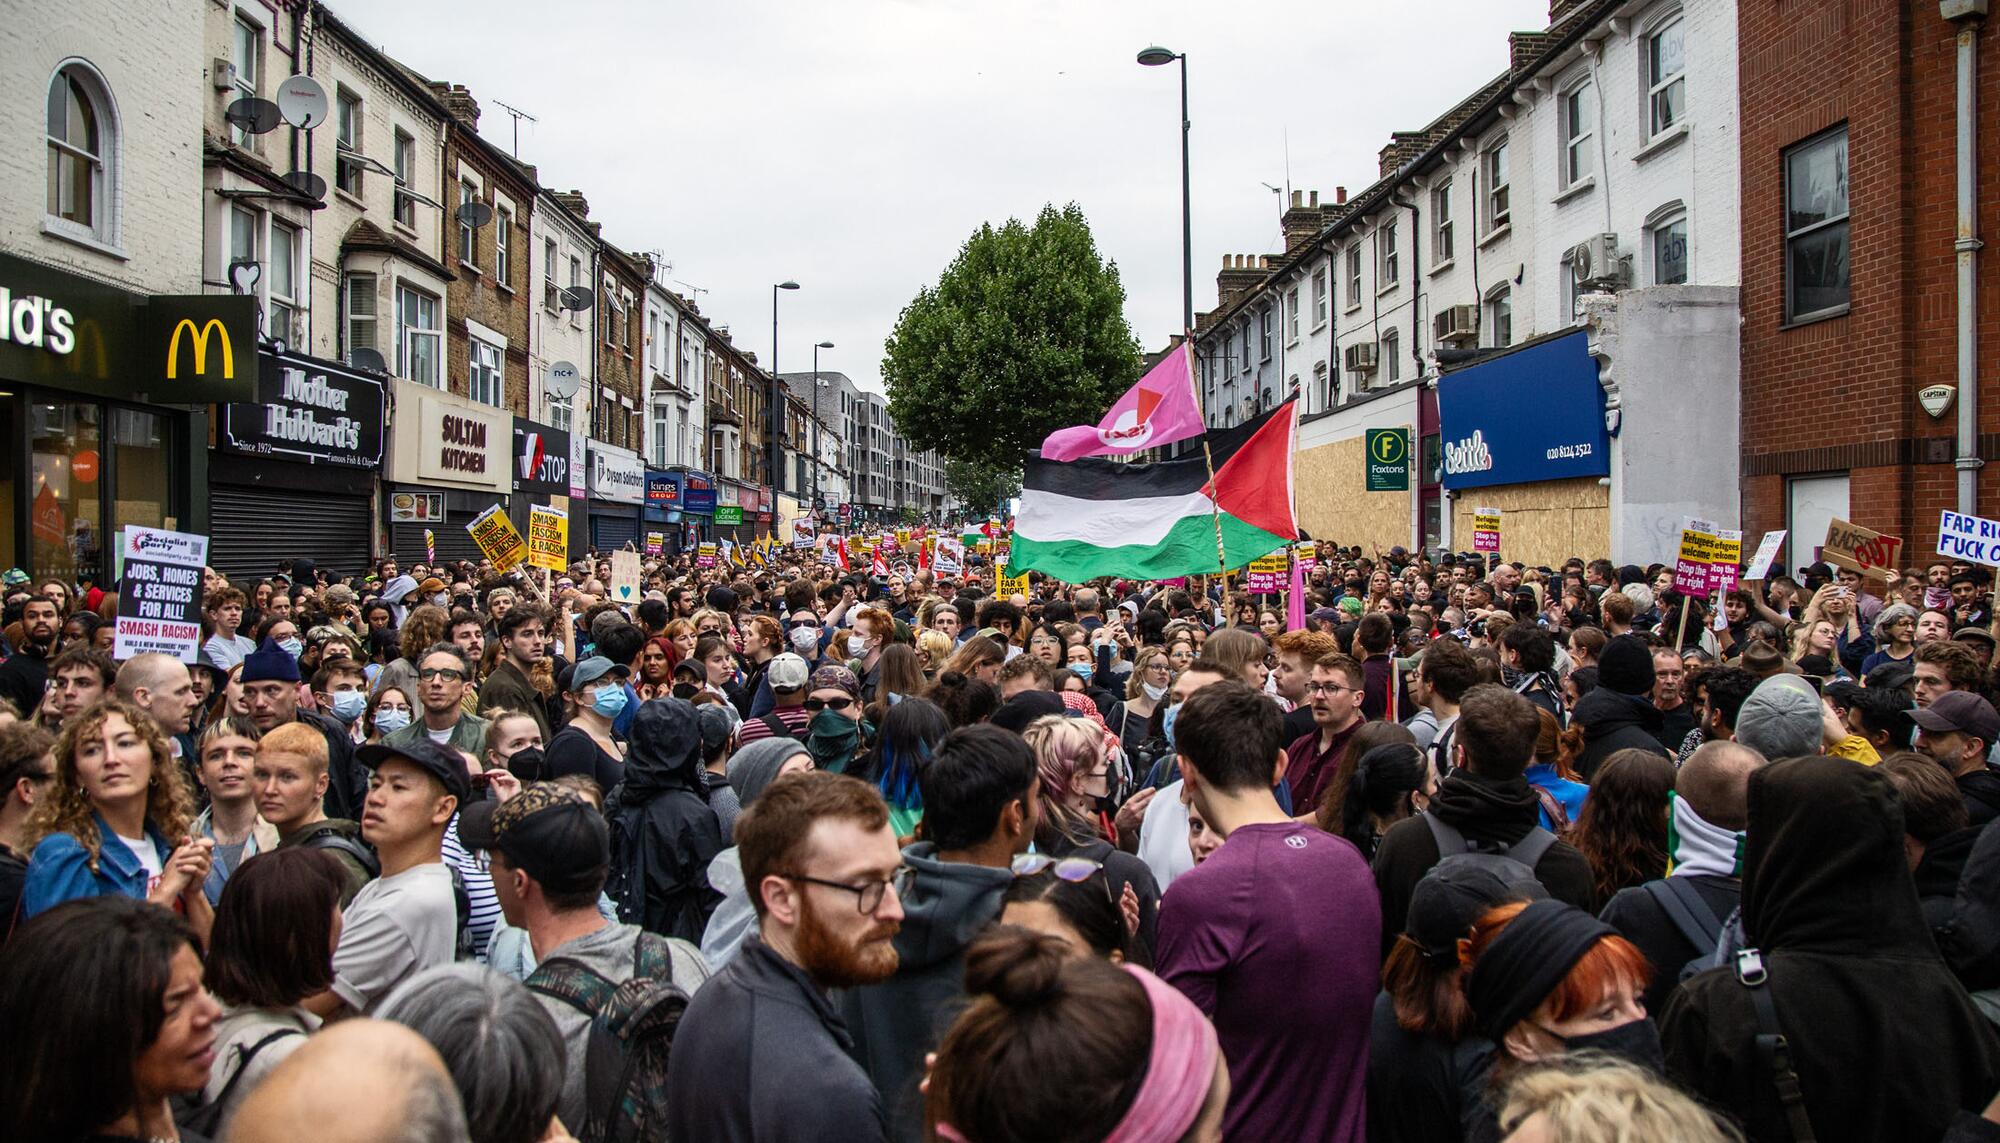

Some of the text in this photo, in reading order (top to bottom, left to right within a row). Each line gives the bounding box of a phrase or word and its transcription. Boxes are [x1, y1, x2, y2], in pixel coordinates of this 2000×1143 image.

[282, 367, 349, 412] Mother
[1923, 390, 1947, 398] CAPSTAN
[266, 403, 359, 450] Hubbard's
[441, 414, 487, 449] SULTAN
[238, 439, 272, 454] Since 1972
[1445, 429, 1489, 474] Settle
[1546, 442, 1592, 460] 020 8124 2522
[327, 452, 375, 468] Famous Fish & Chips
[441, 447, 486, 474] KITCHEN
[606, 467, 623, 487] Dyson
[623, 469, 644, 488] Solicitors
[1371, 464, 1405, 474] Foxtons
[650, 481, 676, 492] kings
[532, 513, 558, 527] SMASH
[1944, 512, 2000, 539] FAR RI
[472, 518, 497, 540] SMASH
[480, 525, 510, 550] FASCISM
[531, 526, 562, 542] FASCISM
[1475, 532, 1490, 541] Stop
[144, 533, 188, 547] Socialist
[489, 551, 497, 561] &
[494, 533, 521, 556] RACISM
[531, 539, 565, 556] & RACISM
[1683, 532, 1714, 549] Refugees
[1714, 541, 1739, 552] efugees
[1940, 533, 1985, 560] FUCK
[1681, 546, 1711, 560] welcome
[1855, 535, 1901, 570] OUT
[127, 563, 199, 586] JOBS, HOMES
[1250, 573, 1266, 582] Stop
[1677, 561, 1707, 577] Stop the
[1724, 564, 1735, 575] the
[1001, 579, 1016, 588] FAR
[1261, 581, 1274, 589] right
[1675, 574, 1705, 590] far right
[133, 583, 193, 603] & SERVICES
[1001, 587, 1025, 596] RIGHT
[139, 600, 185, 620] FOR ALL!
[119, 620, 198, 641] SMASH RACISM
